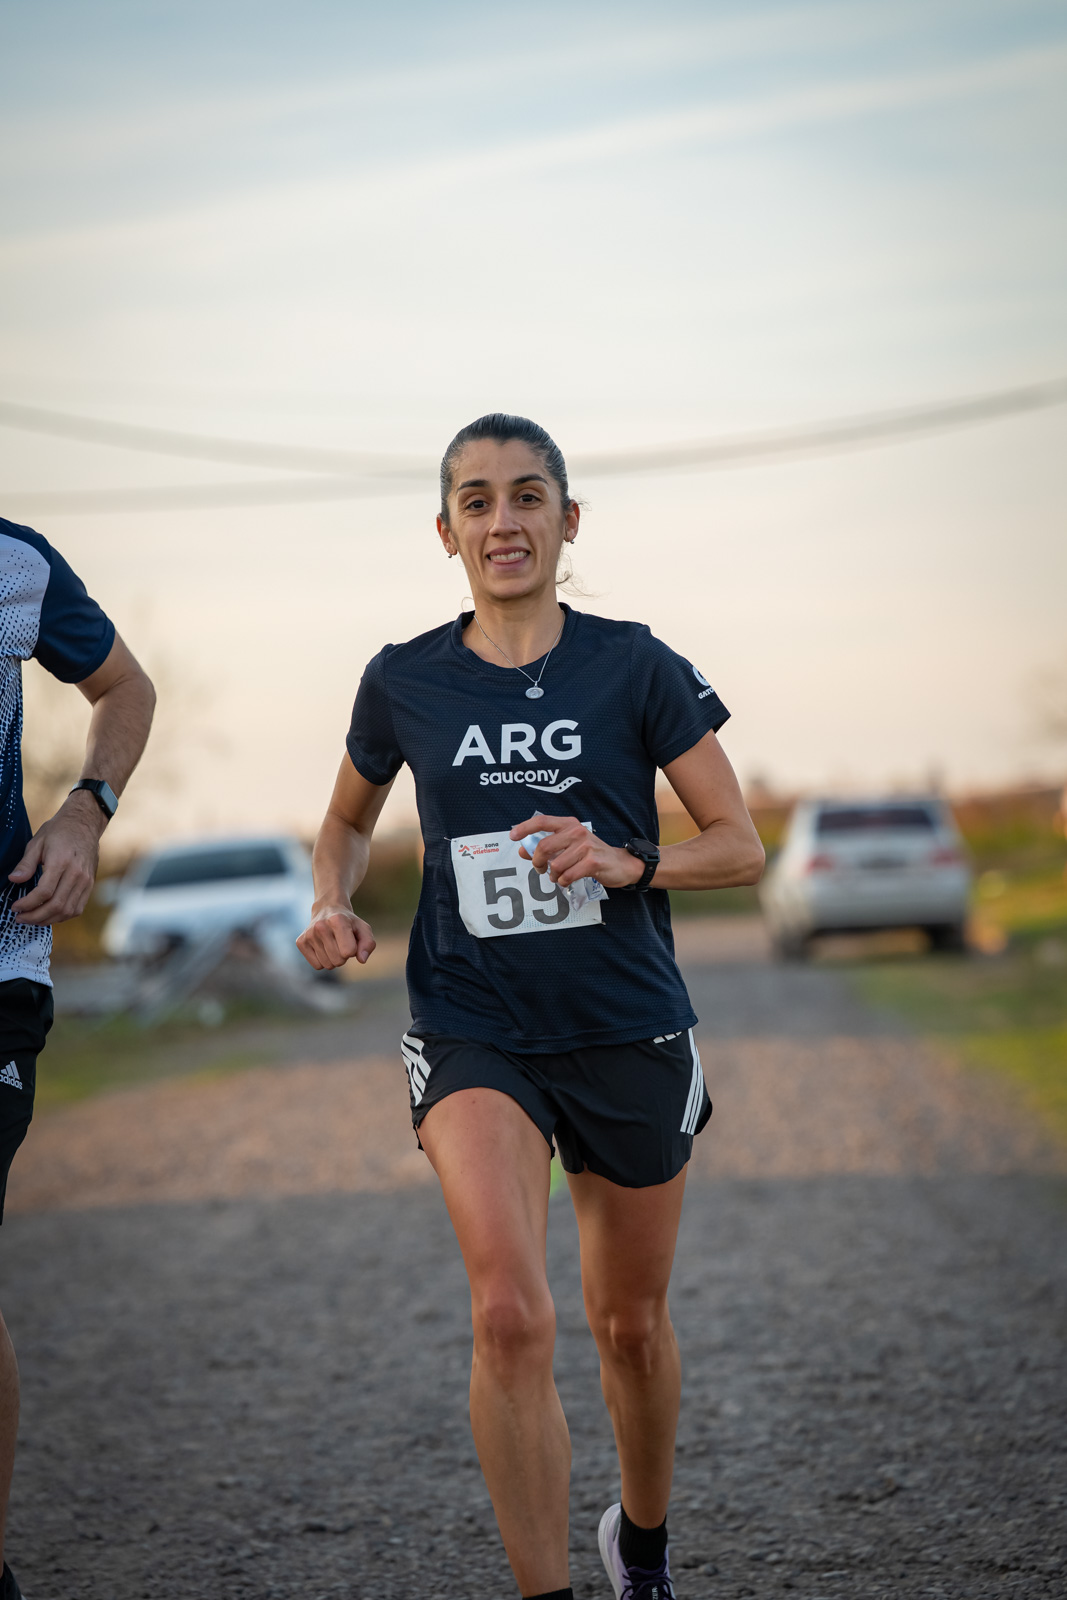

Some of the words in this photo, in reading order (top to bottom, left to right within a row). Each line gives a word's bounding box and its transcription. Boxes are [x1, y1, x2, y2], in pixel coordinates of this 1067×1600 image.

[451, 719, 582, 767] ARG
[479, 769, 560, 786] saucony
[482, 866, 571, 930] 59
[0, 1074, 22, 1089] adidas
